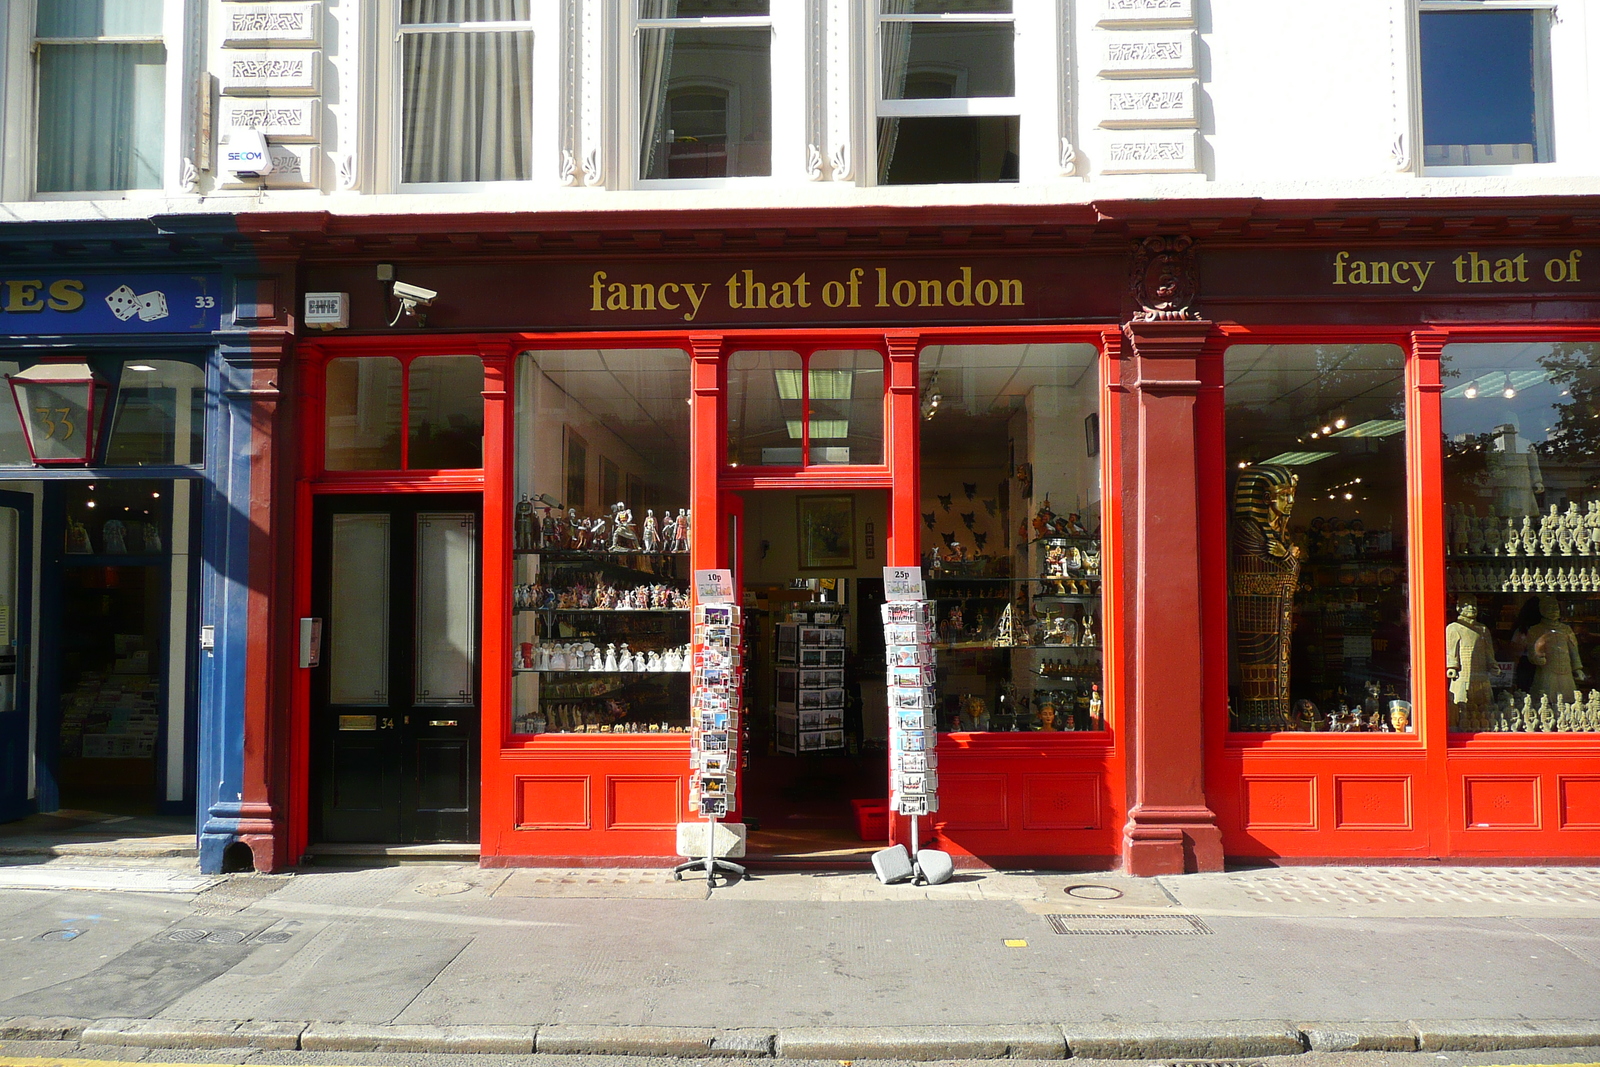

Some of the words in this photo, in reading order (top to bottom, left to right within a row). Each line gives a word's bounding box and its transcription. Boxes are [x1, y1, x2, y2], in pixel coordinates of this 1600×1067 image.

[228, 152, 261, 160] SECOM
[1332, 251, 1435, 292] fancy
[1452, 251, 1529, 283] that
[1544, 249, 1583, 282] of
[0, 279, 84, 311] ES
[589, 270, 711, 321] fancy
[724, 269, 811, 309] that
[821, 267, 864, 308] of
[875, 266, 1025, 308] london
[195, 296, 215, 308] 33
[35, 407, 74, 440] 33
[708, 574, 721, 582] 10p
[894, 571, 910, 579] 25p
[380, 717, 395, 729] 34
